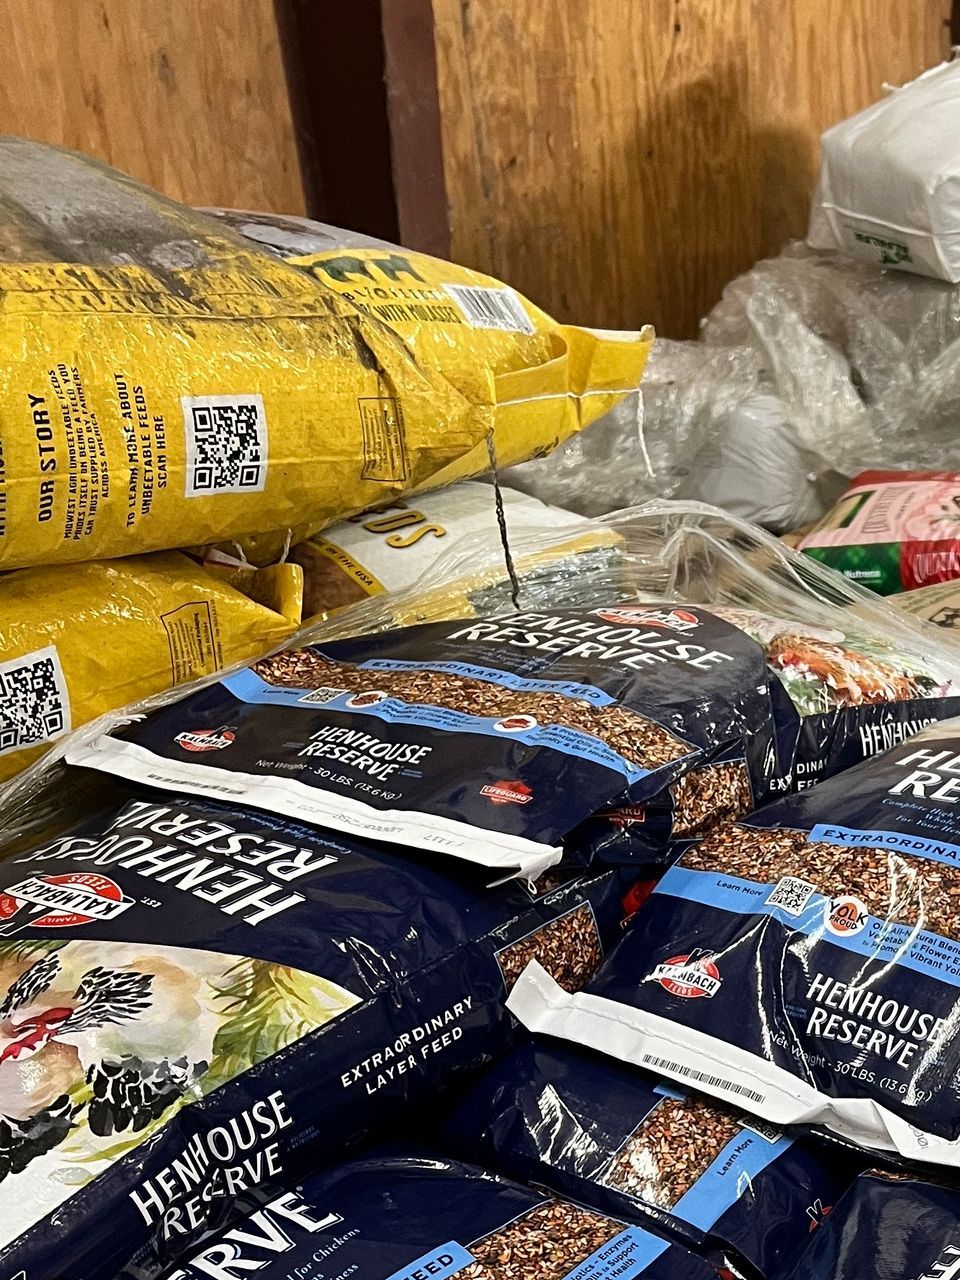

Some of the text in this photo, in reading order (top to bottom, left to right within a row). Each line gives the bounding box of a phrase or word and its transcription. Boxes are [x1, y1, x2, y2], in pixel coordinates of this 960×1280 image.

[28, 393, 56, 522] OUR STORY
[113, 373, 136, 528] TO ABOUT
[133, 386, 154, 515] UNBEETABLE FEEDS
[153, 415, 167, 488] SCAN HERE
[73, 427, 88, 540] PRIDES ITSELF BEING
[64, 498, 76, 538] MIDWEST
[84, 488, 98, 536] CAN TRUST
[446, 622, 668, 671] RESERVE
[370, 660, 601, 699] EXTRAORDINARY LAYER FEED
[298, 742, 401, 782] RESERVE
[307, 725, 433, 765] HENHOUSE
[314, 766, 330, 778] 30
[482, 785, 533, 801] LIFEGUARD
[881, 797, 927, 815] Complete
[11, 879, 121, 917] KALMBACH
[13, 833, 307, 926] HENHOUSE
[67, 874, 112, 891] FEEDS
[716, 880, 764, 897] Learn More
[40, 915, 77, 924] FAMILY
[828, 914, 858, 930] PROUD
[829, 901, 869, 926] YOLK
[909, 950, 944, 971] Vibrant
[919, 944, 951, 963] Flower
[806, 972, 953, 1044] HENHOUSE
[340, 995, 474, 1089] EXTRAORDINARY
[805, 1007, 921, 1071] RESERVE
[364, 1026, 464, 1096] LAYER FEED
[769, 1029, 908, 1099] Net 30 (13.6
[128, 1089, 294, 1228] HENHOUSE
[716, 1137, 754, 1177] Learn More
[161, 1142, 283, 1242] RESERVE
[311, 1226, 362, 1264] Chickens
[598, 1233, 634, 1262] Enzymes
